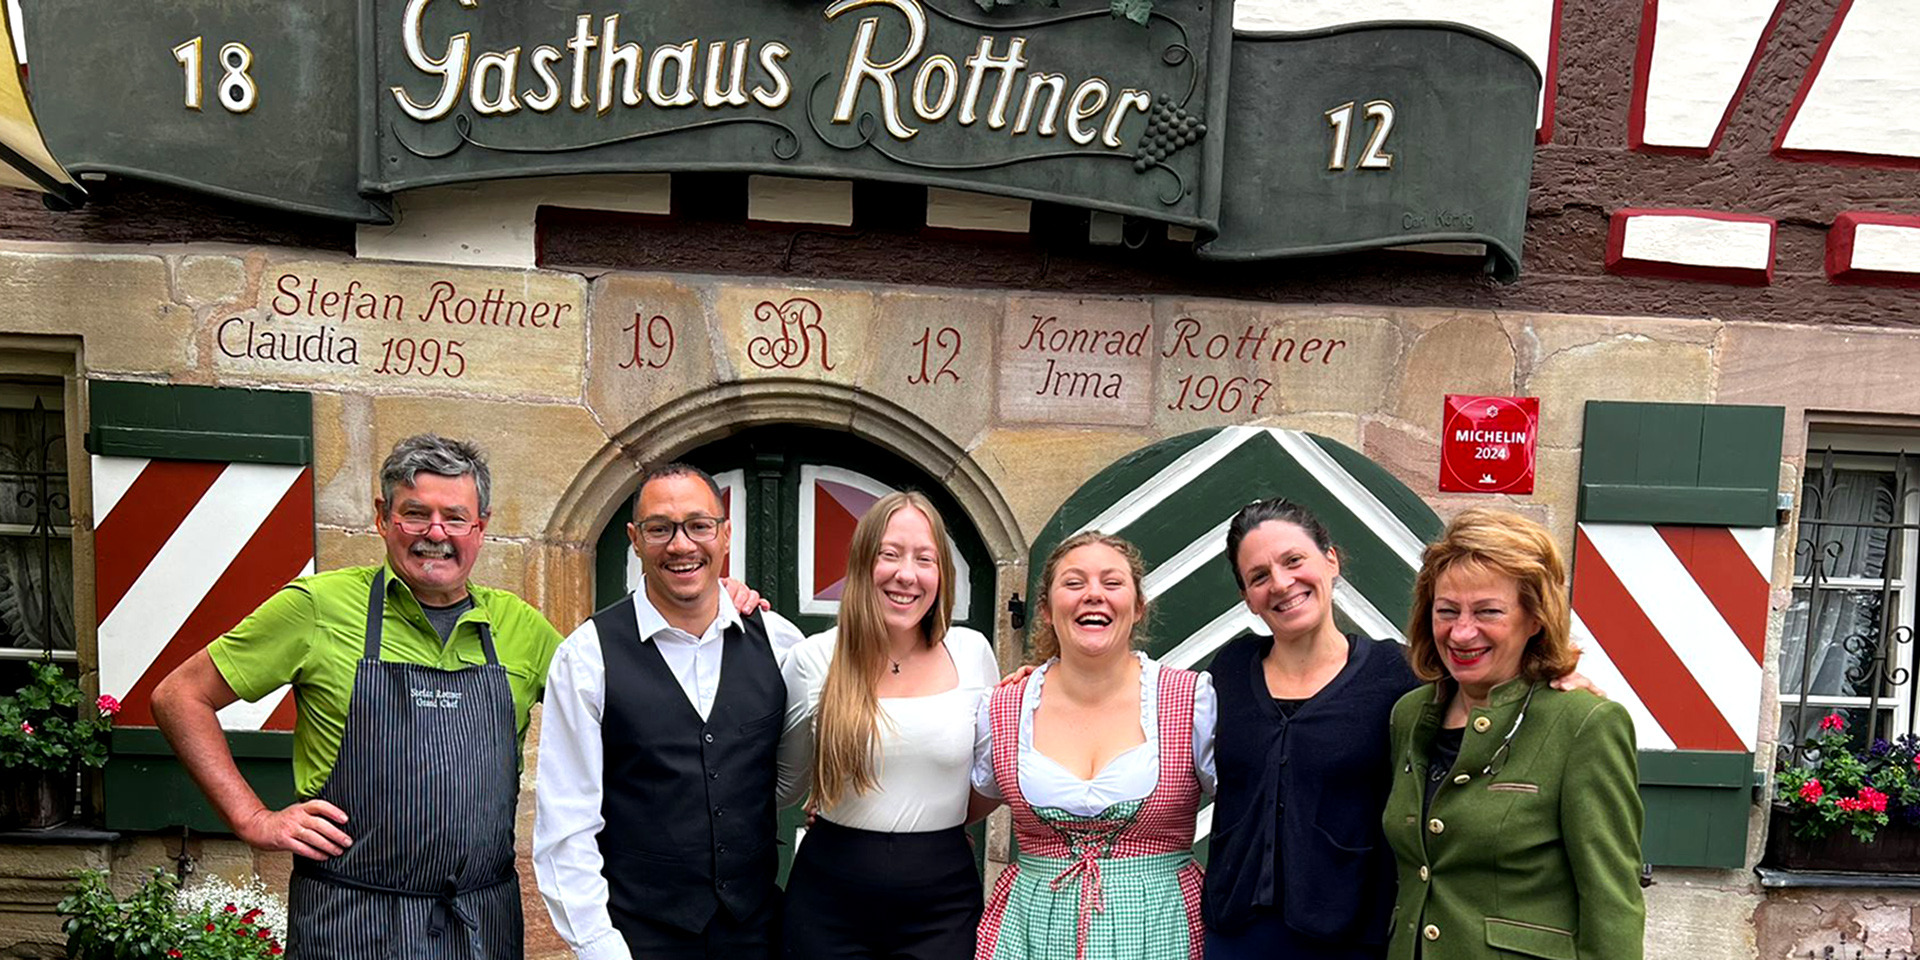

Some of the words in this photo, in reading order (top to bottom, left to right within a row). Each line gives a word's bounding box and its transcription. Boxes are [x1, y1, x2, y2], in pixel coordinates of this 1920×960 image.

[172, 36, 256, 113] 18
[391, 0, 792, 121] Gasthaus
[824, 0, 1152, 148] Rottner
[1325, 100, 1395, 171] 12
[271, 273, 405, 323] Stefan
[418, 280, 572, 329] Rottner
[216, 317, 360, 365] Claudia
[373, 337, 467, 378] 1995
[618, 312, 675, 369] 19
[907, 326, 962, 385] 12
[1018, 315, 1151, 357] Konrad
[1162, 317, 1347, 365] Rottner
[1167, 374, 1273, 416] 1967
[1455, 429, 1527, 444] MICHELIN
[1474, 446, 1507, 461] 2024
